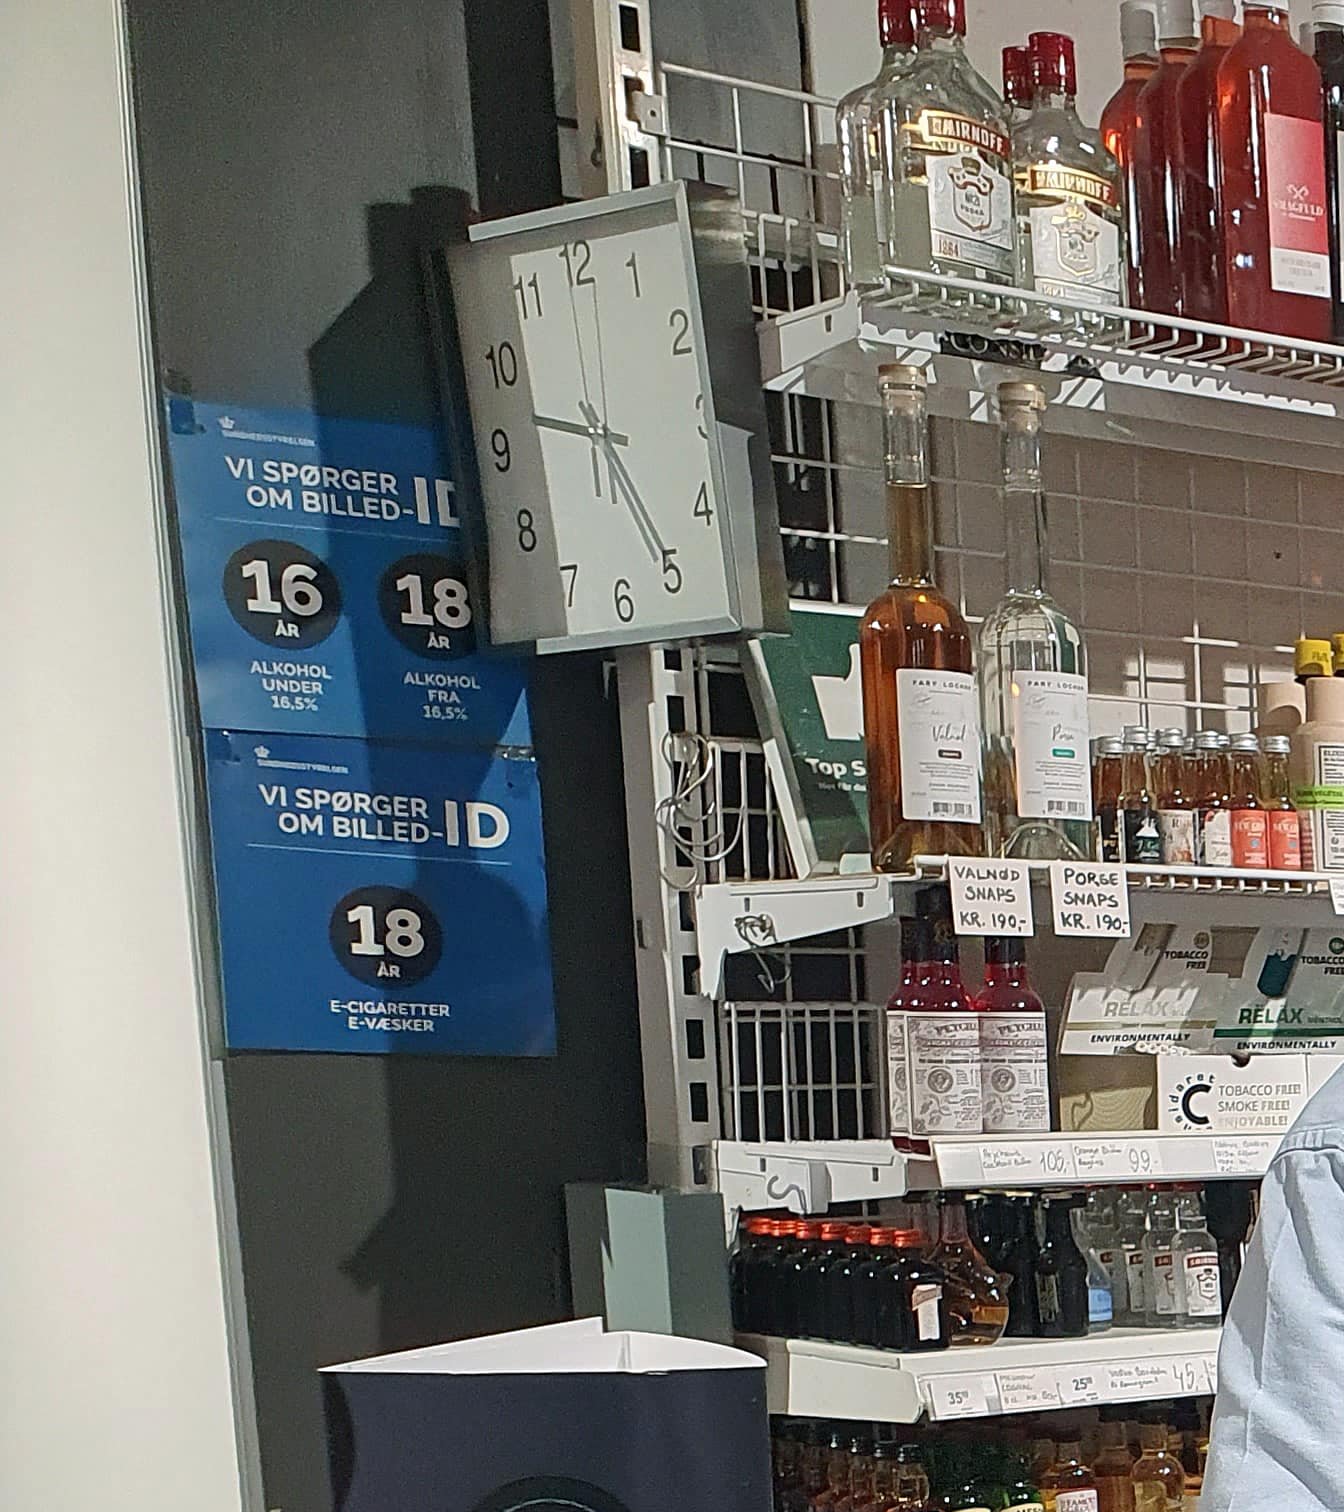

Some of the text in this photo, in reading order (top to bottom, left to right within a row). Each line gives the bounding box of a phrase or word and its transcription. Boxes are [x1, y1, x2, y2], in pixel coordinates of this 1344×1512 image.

[559, 240, 597, 287] 12
[514, 274, 544, 319] 11
[668, 308, 693, 355] 2
[485, 340, 518, 388] 10
[491, 429, 512, 473] 9
[224, 455, 399, 496] VI SPØRGER
[246, 485, 293, 511] OM
[692, 481, 713, 527] 4
[517, 509, 537, 552] 8
[661, 548, 683, 594] 5
[241, 559, 323, 617] 16
[561, 563, 579, 607] 7
[396, 573, 472, 630] 18
[613, 578, 636, 623] 6
[274, 619, 300, 639] ÅR
[427, 631, 450, 650] ÅR
[250, 660, 333, 680] ALKOHOL
[403, 670, 481, 690] ALKOHOL
[262, 678, 323, 695] UNDER
[428, 688, 460, 704] FRA
[805, 757, 847, 779] Top
[258, 783, 429, 819] VI SPØRGER
[278, 813, 323, 836] OM
[965, 885, 1015, 903] SNAPS
[1063, 891, 1119, 908] SNAPS
[960, 911, 987, 928] KR.
[1060, 911, 1091, 930] KR.
[347, 905, 425, 957] 18
[1164, 950, 1208, 960] TOBACCO
[1186, 960, 1207, 970] FREE
[376, 961, 400, 979] ÅR
[330, 999, 450, 1017] E-CIGARETTER
[1104, 1001, 1168, 1017] RELAX
[1238, 1007, 1303, 1025] RELAX
[348, 1016, 435, 1032] E-VÆSKER
[1090, 1033, 1190, 1043] ENVIRONMENTALLY
[1236, 1040, 1336, 1050] ENVIRONMENTALLY
[1218, 1085, 1273, 1097] TOBACCO
[1218, 1100, 1290, 1112] SMOKE FREE!
